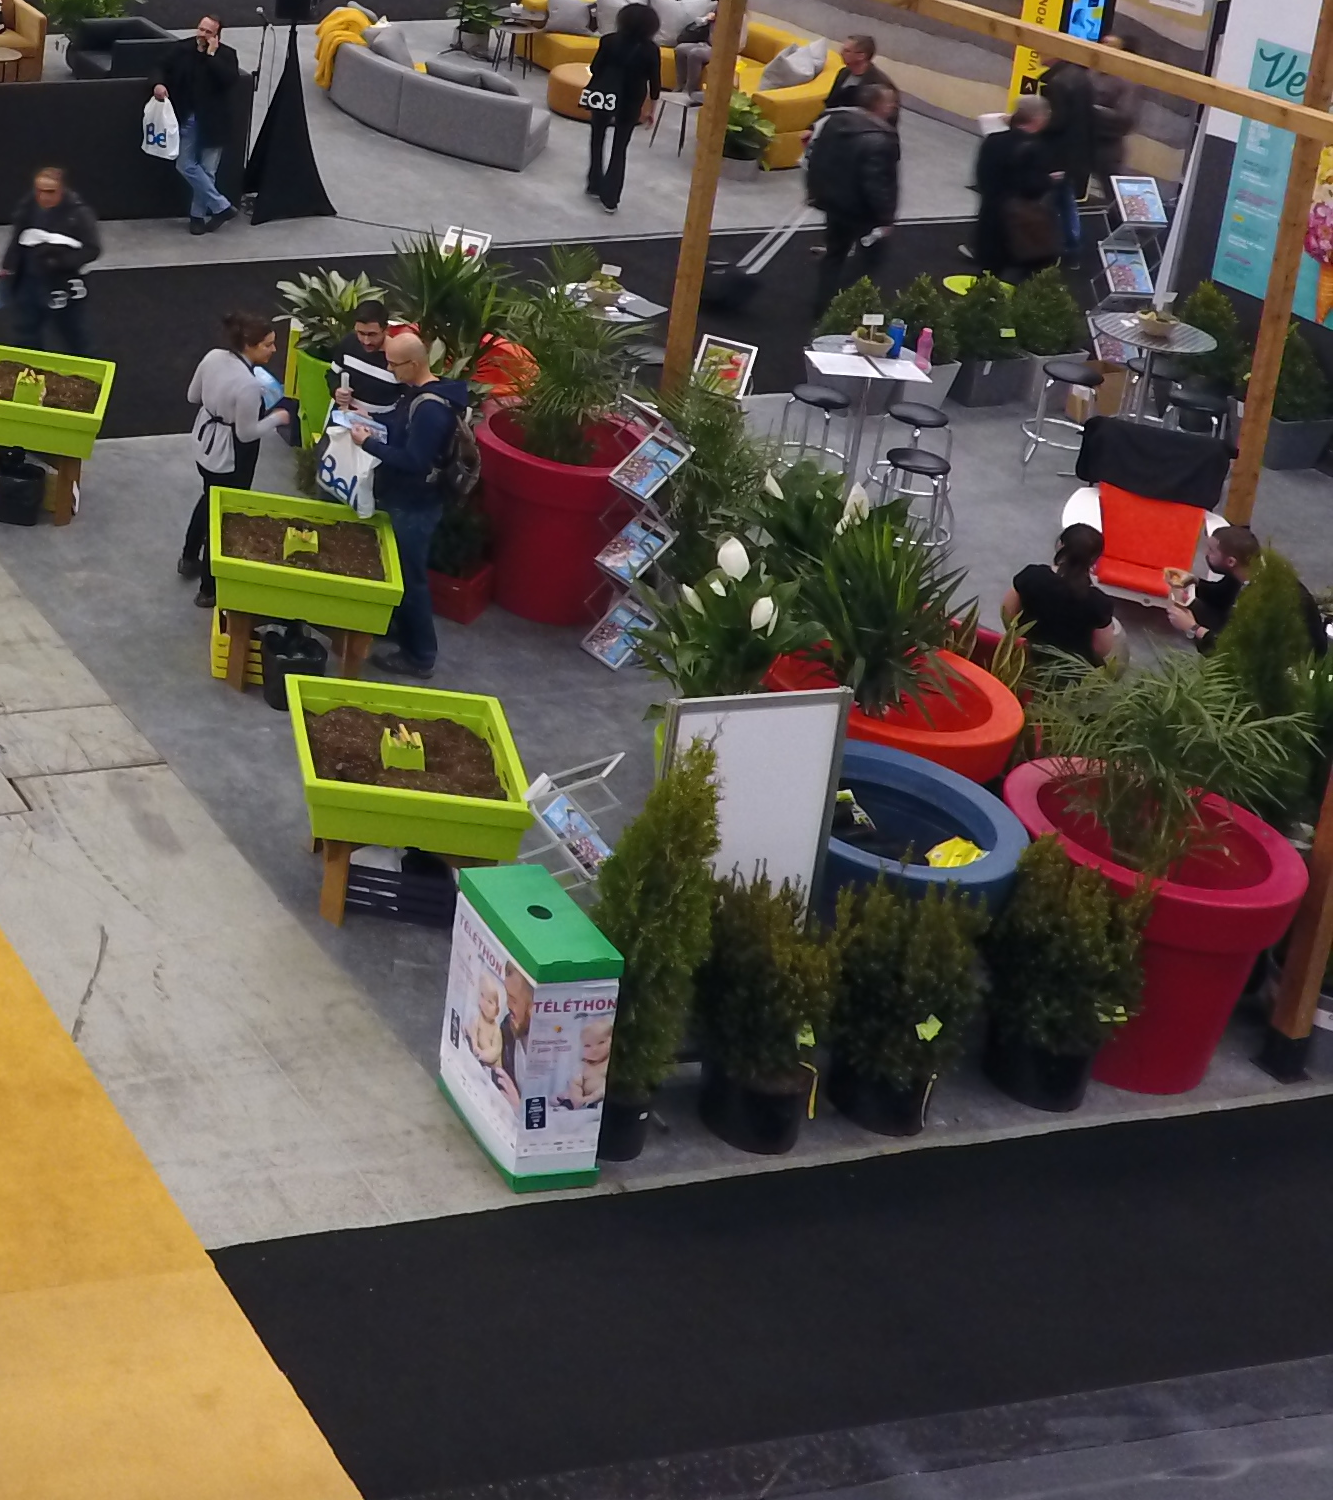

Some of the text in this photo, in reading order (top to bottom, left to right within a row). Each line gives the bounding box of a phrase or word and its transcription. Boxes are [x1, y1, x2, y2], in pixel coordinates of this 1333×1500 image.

[581, 88, 617, 111] EQ3
[458, 912, 504, 977] TÉLÉTHON
[533, 998, 617, 1014] TÉLÉTHON
